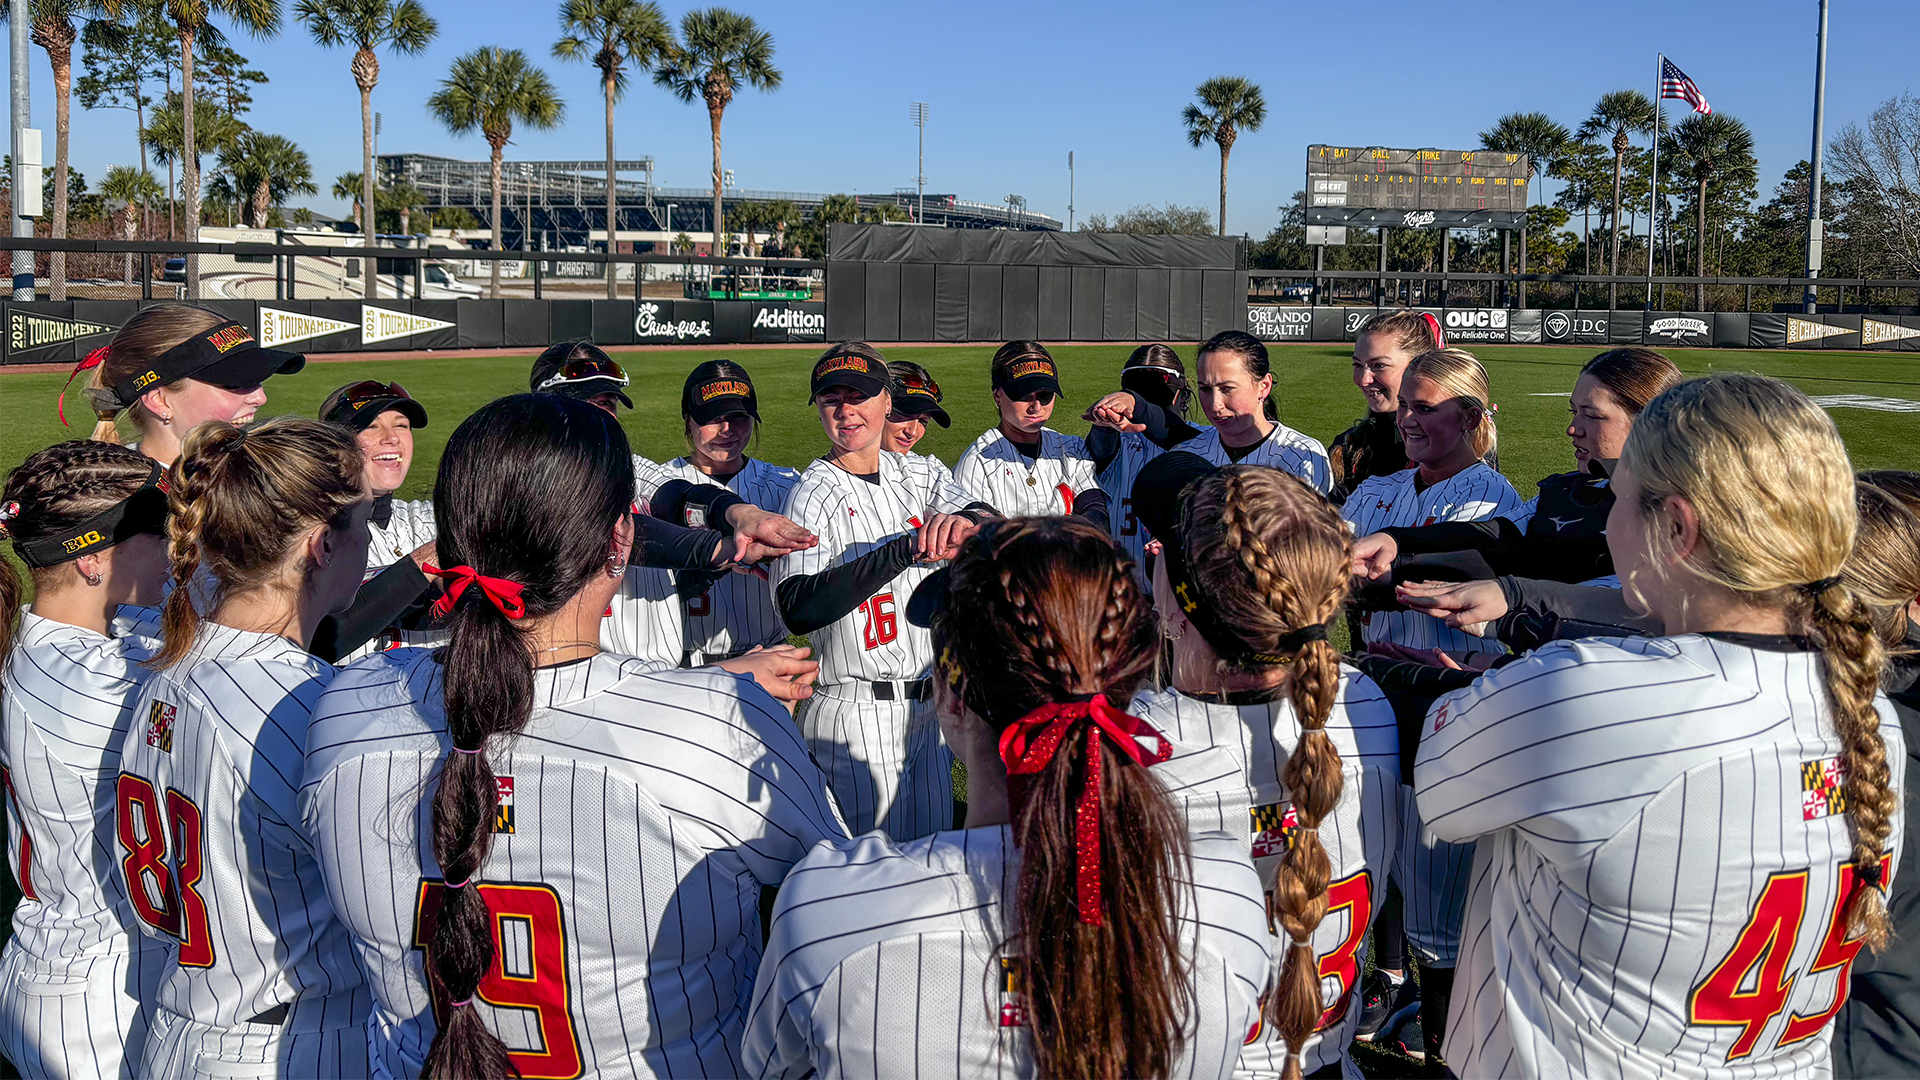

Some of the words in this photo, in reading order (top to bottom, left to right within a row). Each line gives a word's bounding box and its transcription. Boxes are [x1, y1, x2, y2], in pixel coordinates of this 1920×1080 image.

[1319, 148, 1330, 158] AT
[1334, 149, 1349, 158] BAT
[1372, 149, 1390, 159] BALL
[1416, 151, 1440, 160] STRIKE
[1461, 152, 1475, 162] OUT
[1506, 153, 1518, 163] H/E
[1364, 174, 1369, 182] 2
[1399, 175, 1404, 183] 5
[1433, 176, 1438, 184] 8
[1443, 176, 1448, 184] 9
[1471, 177, 1486, 185] RUNS
[1513, 178, 1525, 186] ERR
[1402, 211, 1436, 228] Knights
[366, 309, 375, 339] 2025
[379, 312, 437, 337] TOURNAMENT
[635, 303, 711, 340] Chick-fil-A
[753, 308, 825, 328] Addition
[1248, 309, 1312, 323] ORLANDO
[1446, 311, 1489, 327] OUC
[1656, 320, 1677, 329] GOOD
[1679, 320, 1703, 330] GREEK
[12, 315, 23, 349] 2022
[28, 317, 102, 346] TOURNAMENT
[264, 312, 274, 342] 2024
[278, 314, 341, 340] TOURNAMENT
[1254, 322, 1305, 336] HEALTH
[1572, 319, 1606, 333] IDC
[1789, 320, 1797, 341] 2005
[1799, 322, 1844, 340] CHAMPIONS
[1864, 321, 1872, 342] 2008
[1874, 322, 1920, 341] CHAMPIONS
[1446, 331, 1460, 339] The
[1461, 331, 1489, 340] Reliable
[1489, 331, 1505, 340] One
[817, 356, 868, 377] MARYLAND
[701, 381, 750, 397] MARYLAND
[858, 592, 898, 651] 26
[1687, 848, 1893, 1067] 45
